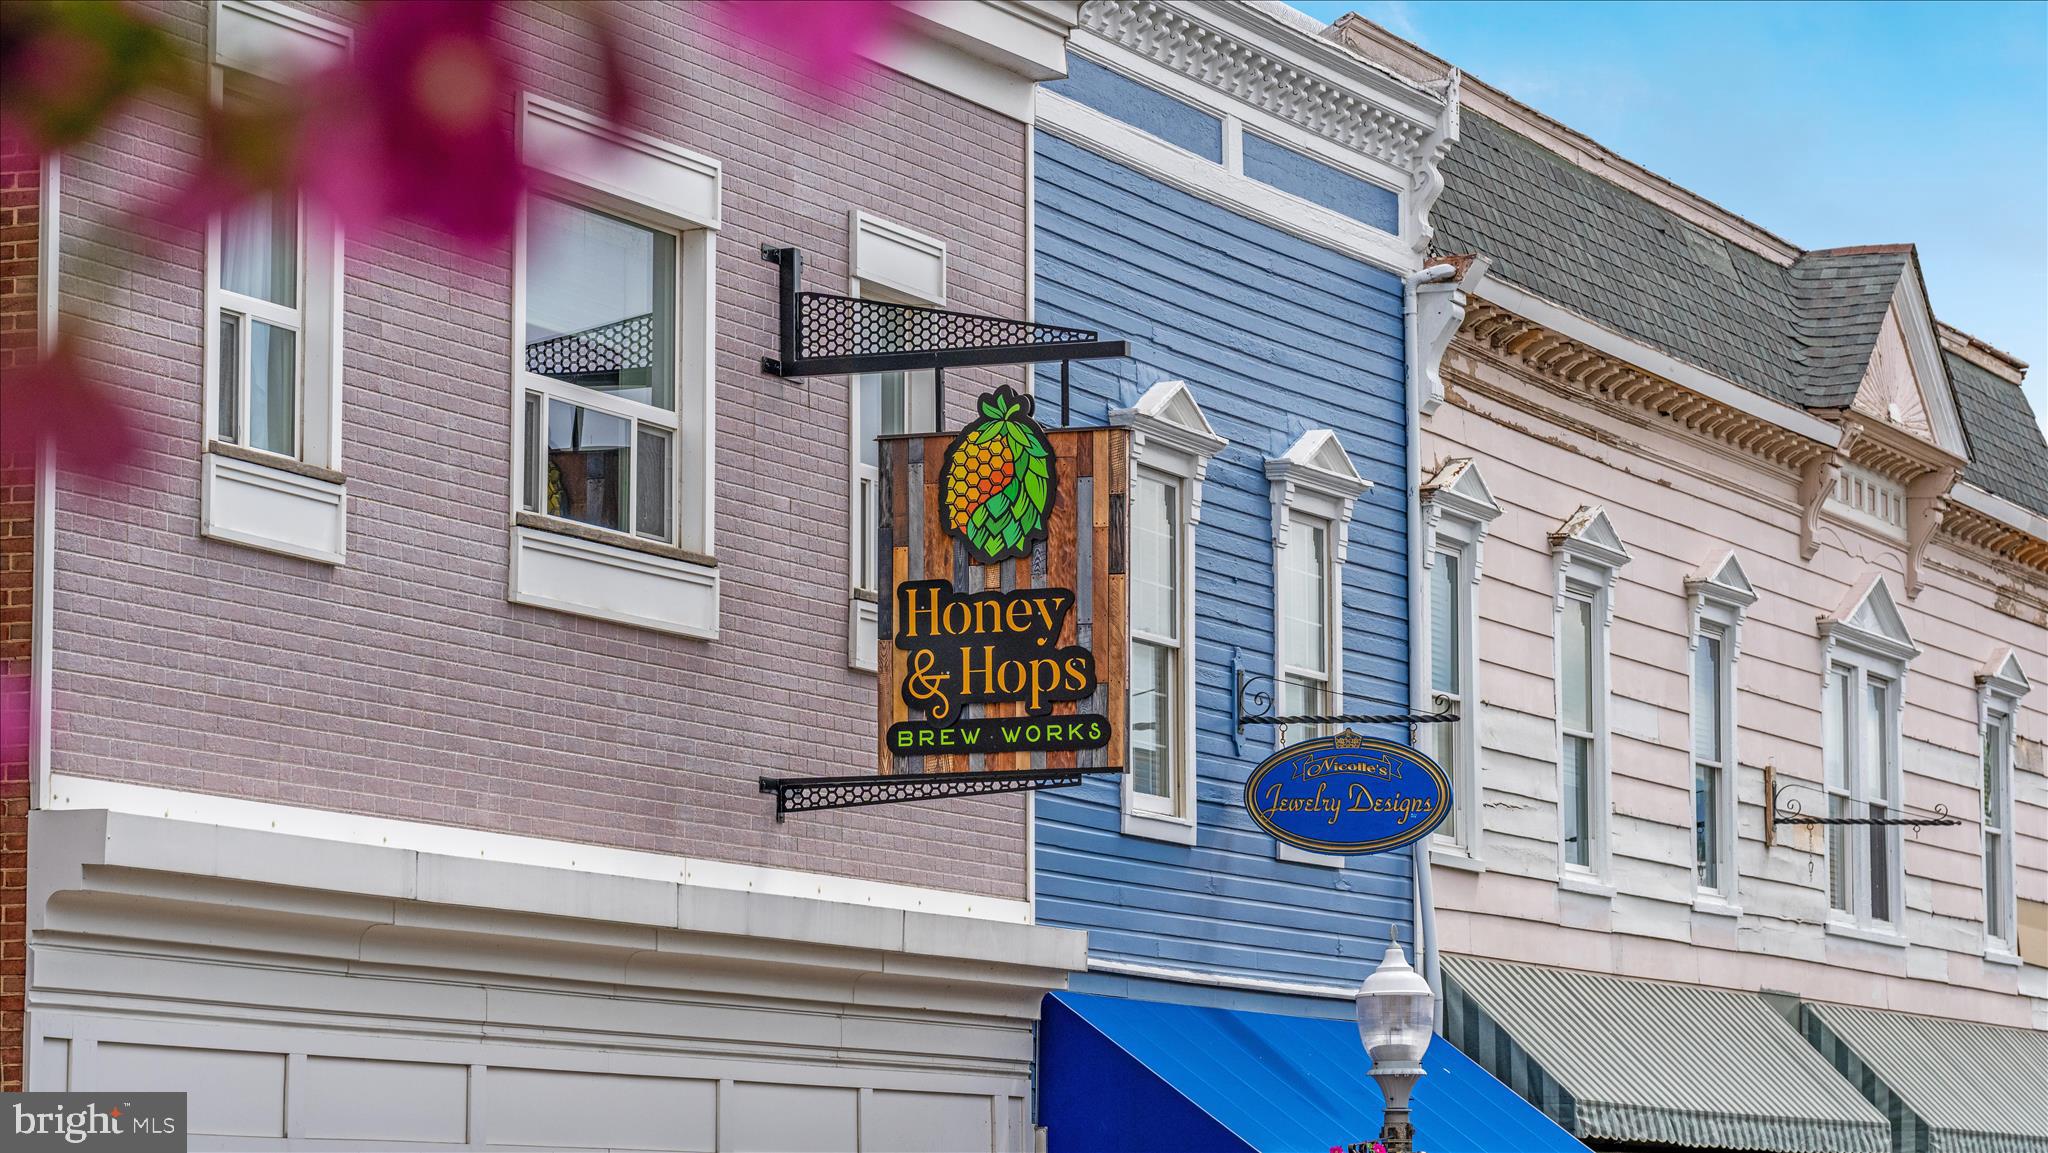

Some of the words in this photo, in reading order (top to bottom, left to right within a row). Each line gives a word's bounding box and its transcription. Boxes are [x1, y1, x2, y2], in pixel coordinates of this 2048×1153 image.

[905, 587, 1065, 646] Honey
[908, 648, 950, 719] &
[959, 645, 1086, 709] Hops
[897, 728, 981, 747] BREW
[1001, 722, 1101, 743] WORKS
[1306, 757, 1388, 777] Nicolle's
[1261, 782, 1341, 825] Jewelry
[1346, 783, 1434, 825] Designs
